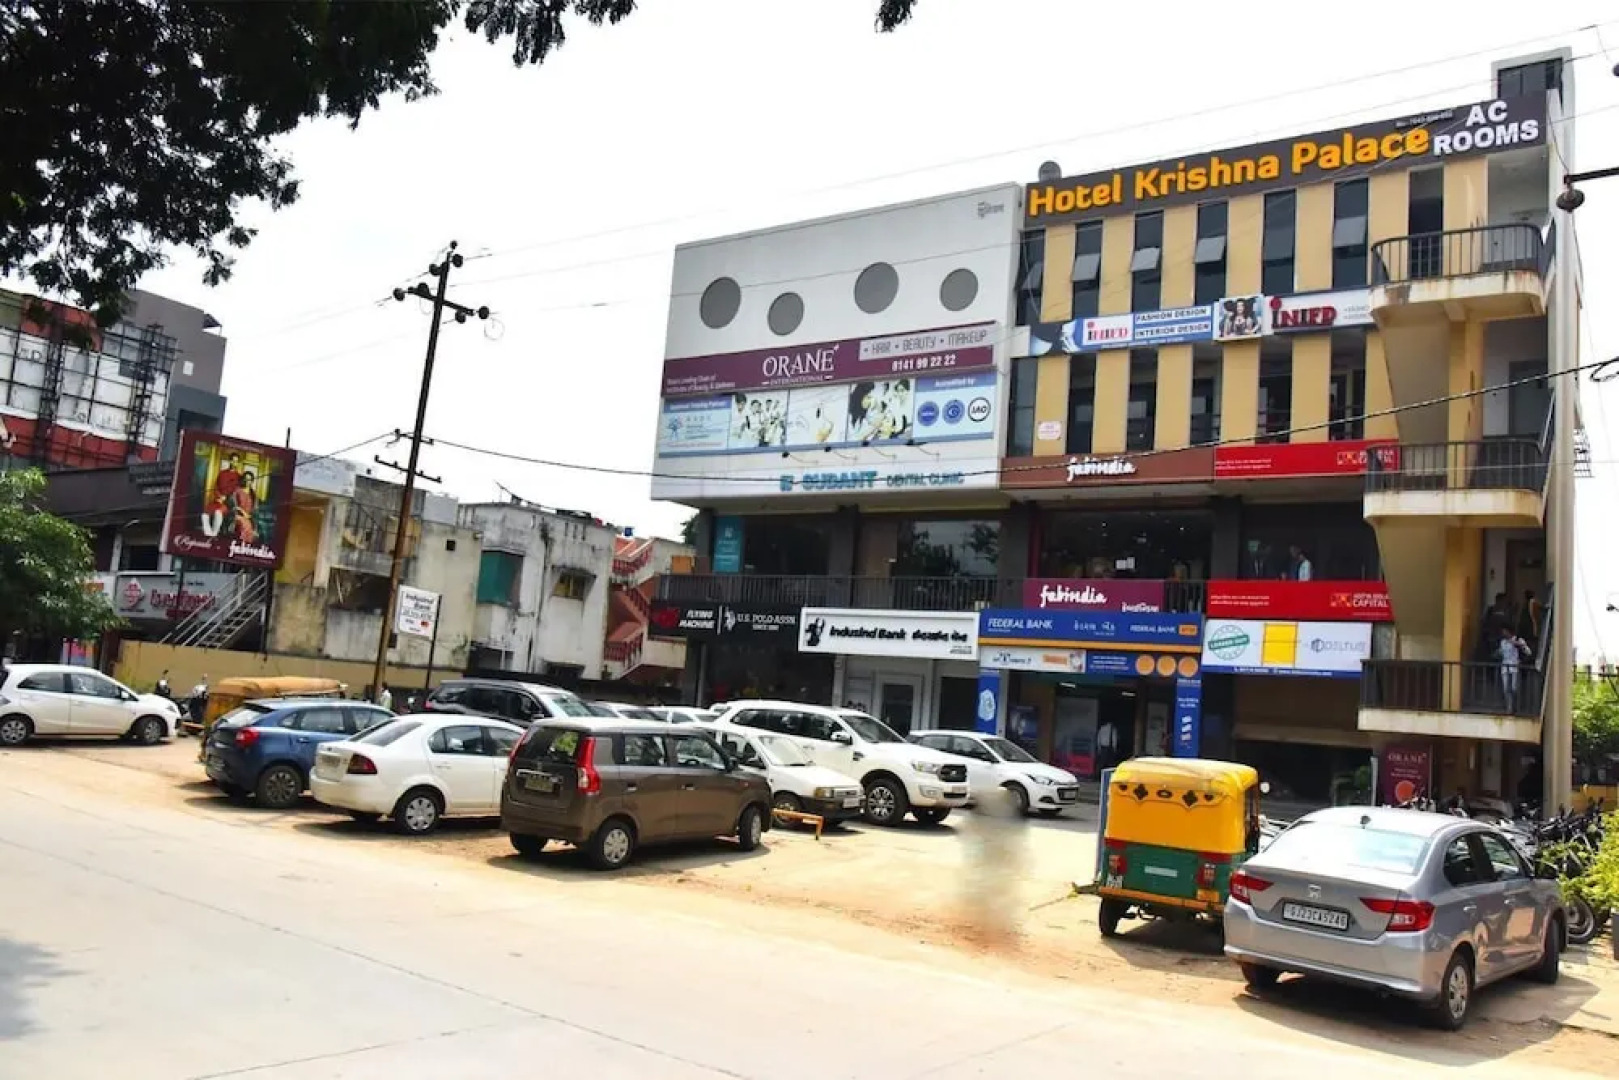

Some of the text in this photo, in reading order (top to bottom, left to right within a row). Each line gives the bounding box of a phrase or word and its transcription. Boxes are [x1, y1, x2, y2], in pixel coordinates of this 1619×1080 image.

[1466, 101, 1508, 127] AC
[1433, 119, 1539, 156] ROOMS
[1029, 128, 1430, 216] Hotel Krishna Palace
[1136, 308, 1207, 321] FASHION DESIGN
[1136, 327, 1176, 338] INTERIOR
[903, 336, 937, 352] BEAUTY
[763, 348, 835, 378] ORANE
[1067, 455, 1137, 482] fabindia
[1040, 584, 1107, 608] fabindia
[1352, 599, 1389, 608] CAPITAL
[987, 618, 1053, 629] FEDERAL BANK
[1129, 624, 1156, 633] FEDERAL
[1157, 625, 1176, 634] BANK
[878, 627, 906, 641] Bank
